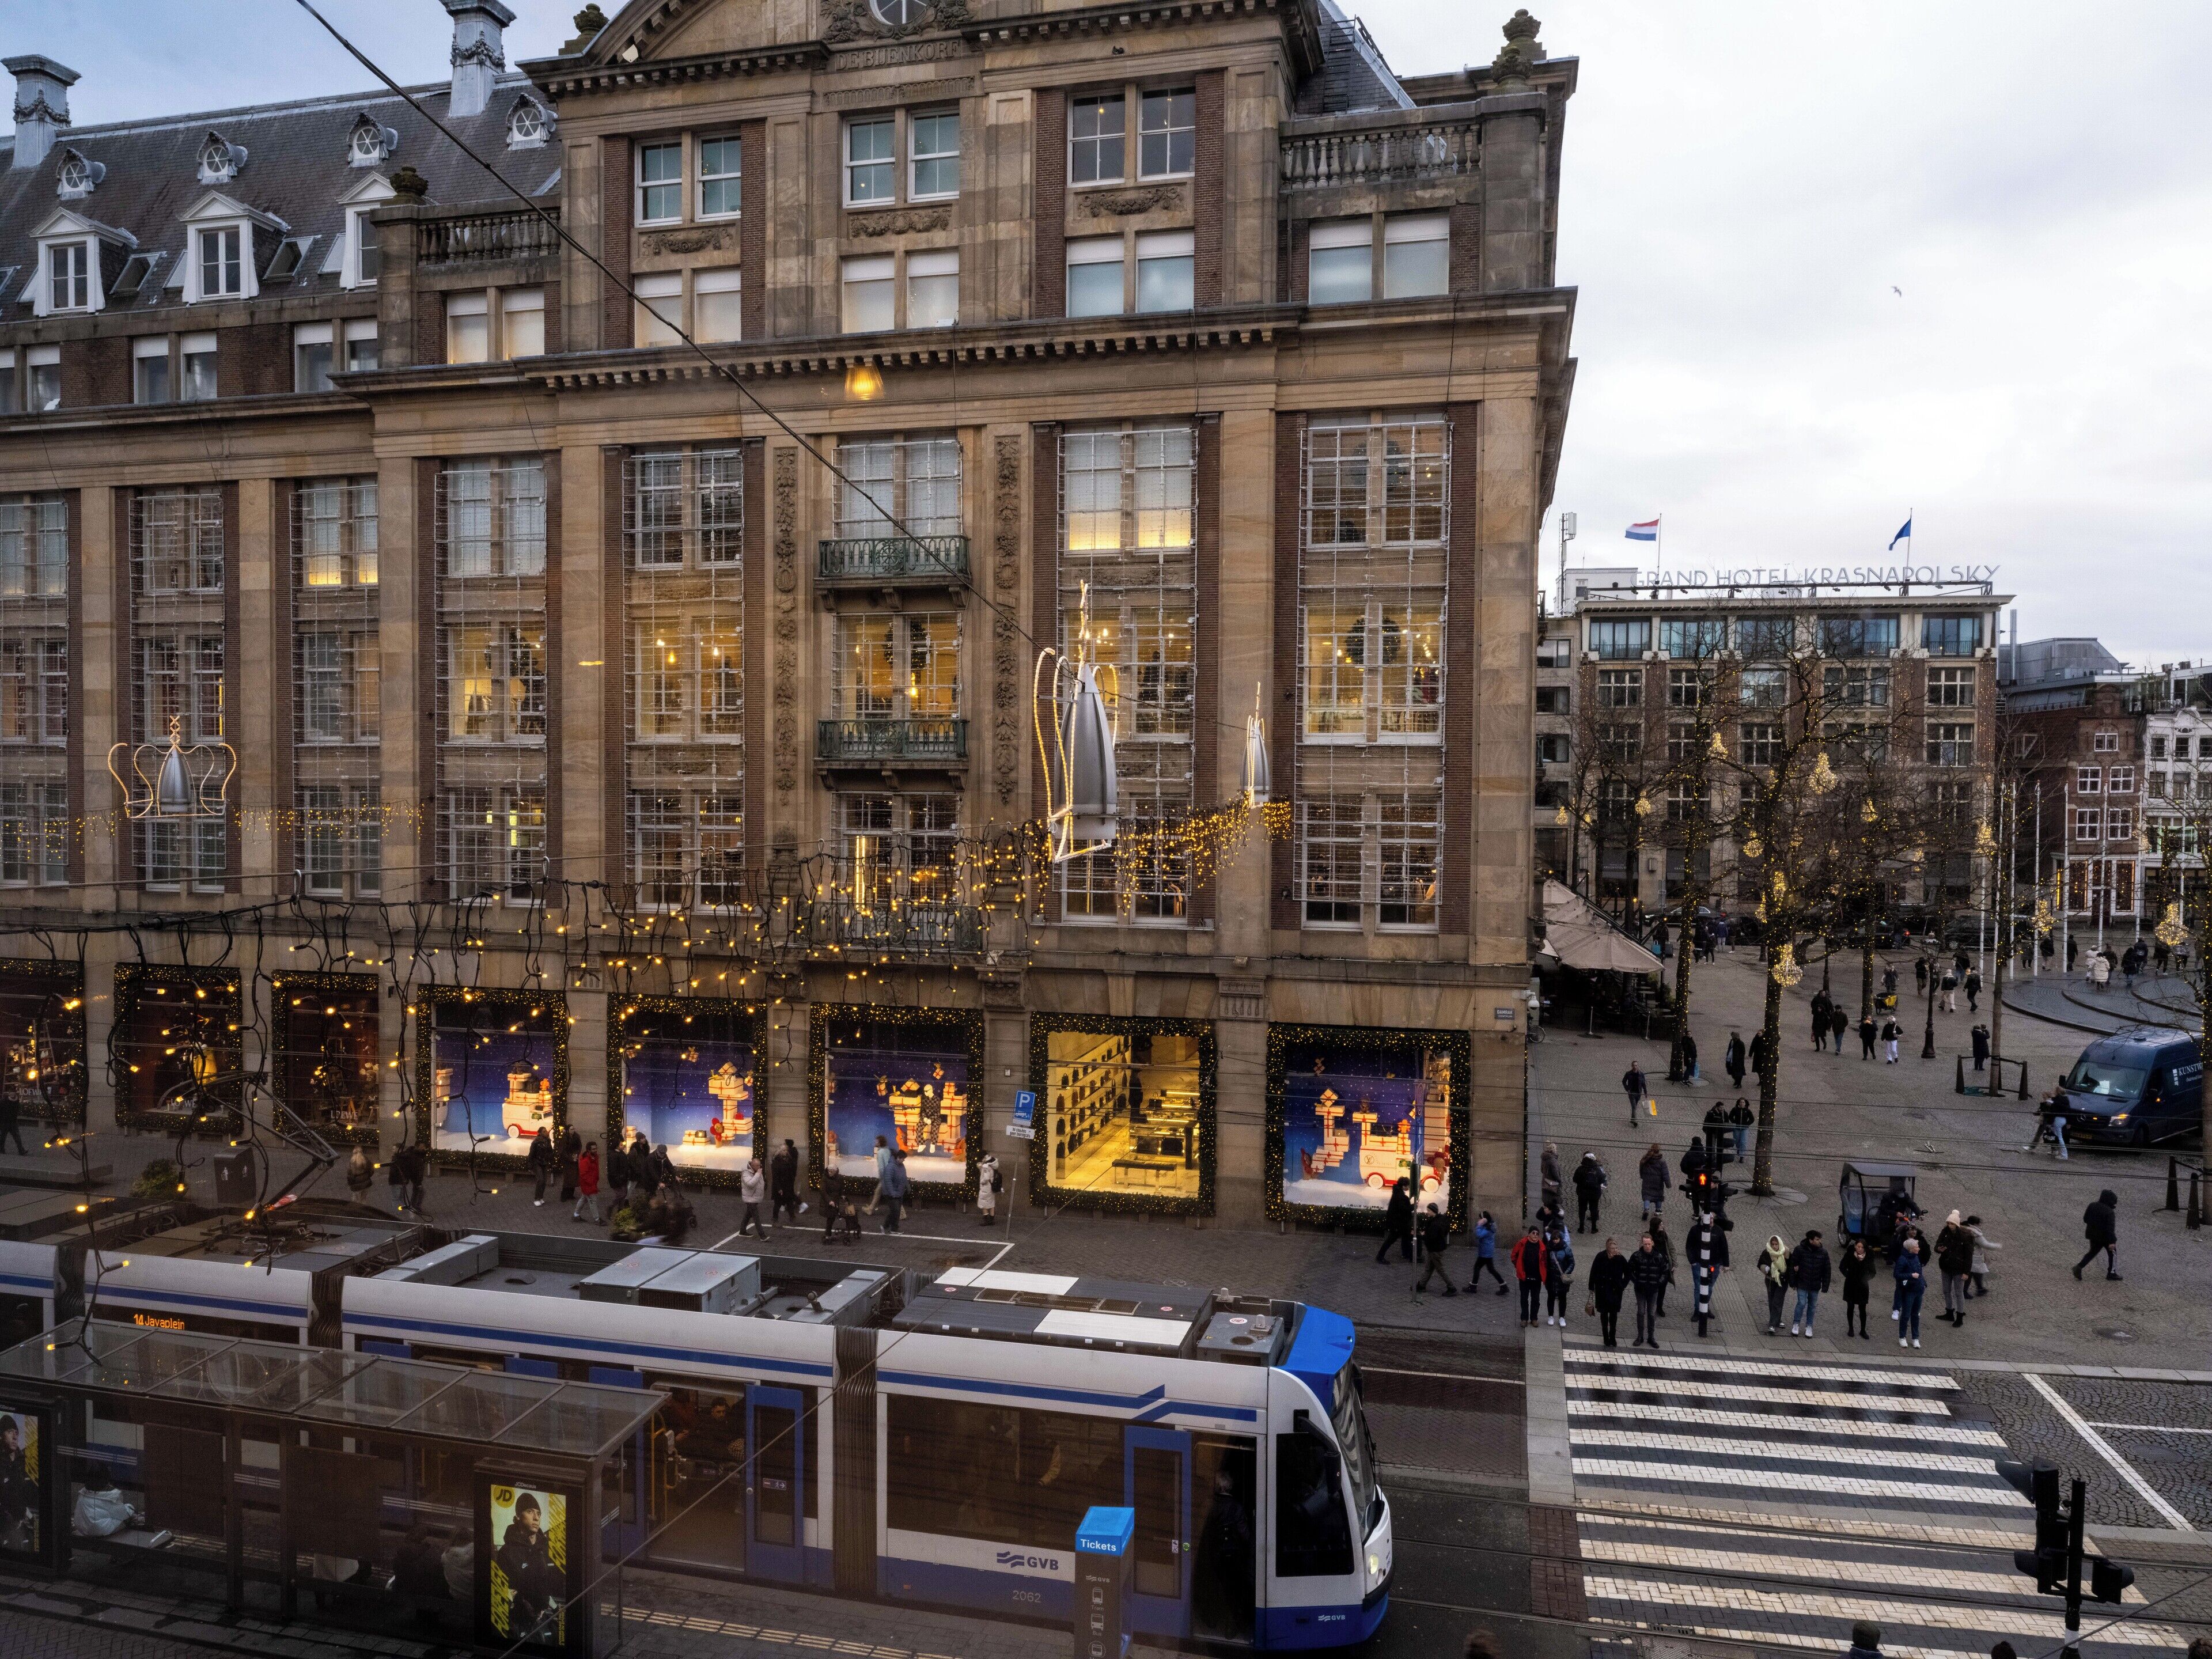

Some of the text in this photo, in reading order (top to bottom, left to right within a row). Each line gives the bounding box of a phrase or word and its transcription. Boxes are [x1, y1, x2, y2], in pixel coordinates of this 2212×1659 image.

[836, 52, 860, 70] DE
[1630, 565, 2001, 588] GRAND HOTEL KRASNAPOLSKY
[2178, 1062, 2203, 1076] KUNSTW
[171, 1098, 196, 1108] LOWE
[1019, 1093, 1031, 1108] P
[133, 1314, 185, 1330] 14 Javaplein
[496, 1488, 513, 1502] JD
[1080, 1539, 1116, 1552] Tickets
[1027, 1555, 1059, 1571] GVB
[1012, 1590, 1041, 1603] 2062
